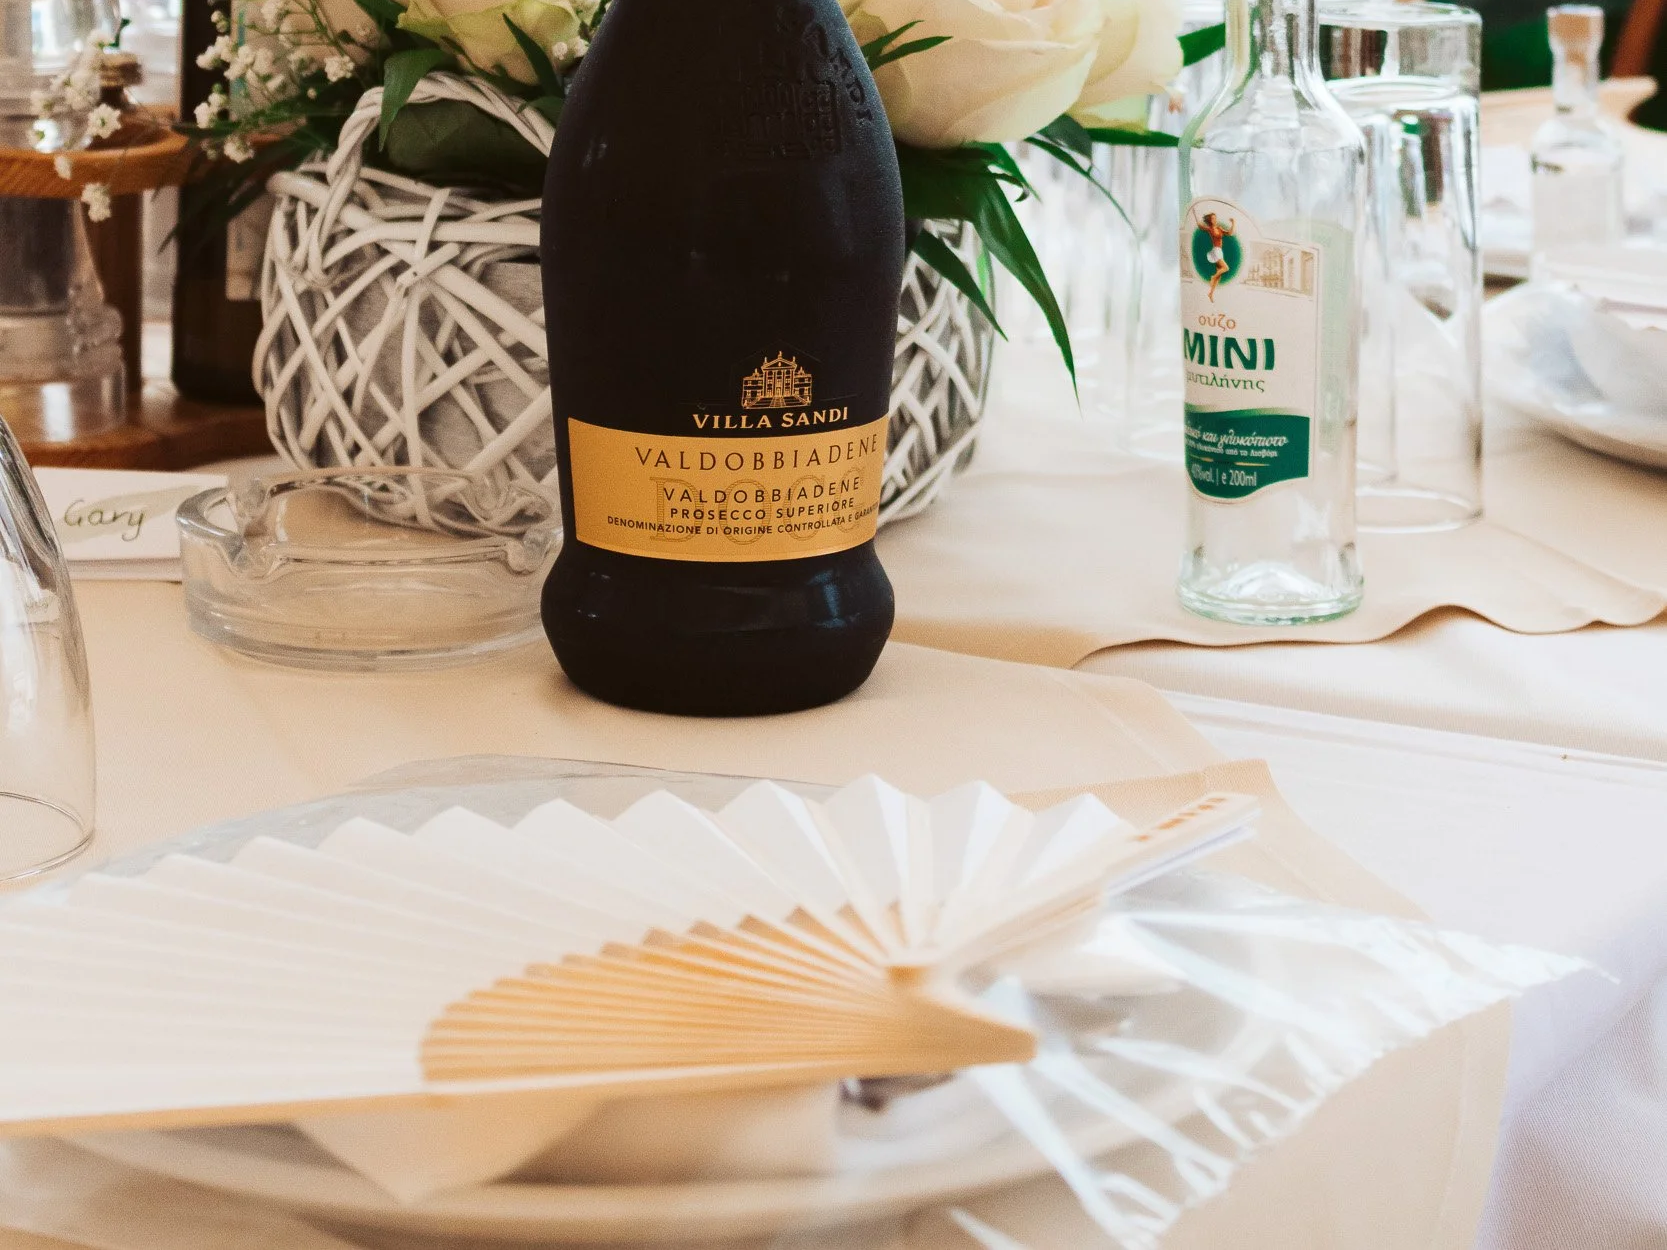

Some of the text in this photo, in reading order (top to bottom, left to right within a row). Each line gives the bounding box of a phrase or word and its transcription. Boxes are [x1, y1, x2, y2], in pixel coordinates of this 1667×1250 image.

[1198, 313, 1236, 331] ούζο
[1183, 327, 1275, 371] MINI
[693, 406, 849, 429] VILLA SANDI
[634, 434, 878, 471] VALDOBBIADENE
[663, 476, 860, 503] VALDOBBIADENE
[1229, 469, 1257, 487] 200ml
[64, 499, 144, 542] Gary
[670, 497, 855, 521] PROSECCO SUPERIORE
[607, 515, 701, 535] DENOMINAZIONE
[706, 526, 718, 535] DI
[723, 525, 772, 535] ORIGINE
[777, 515, 845, 533] CONTROLLATA
